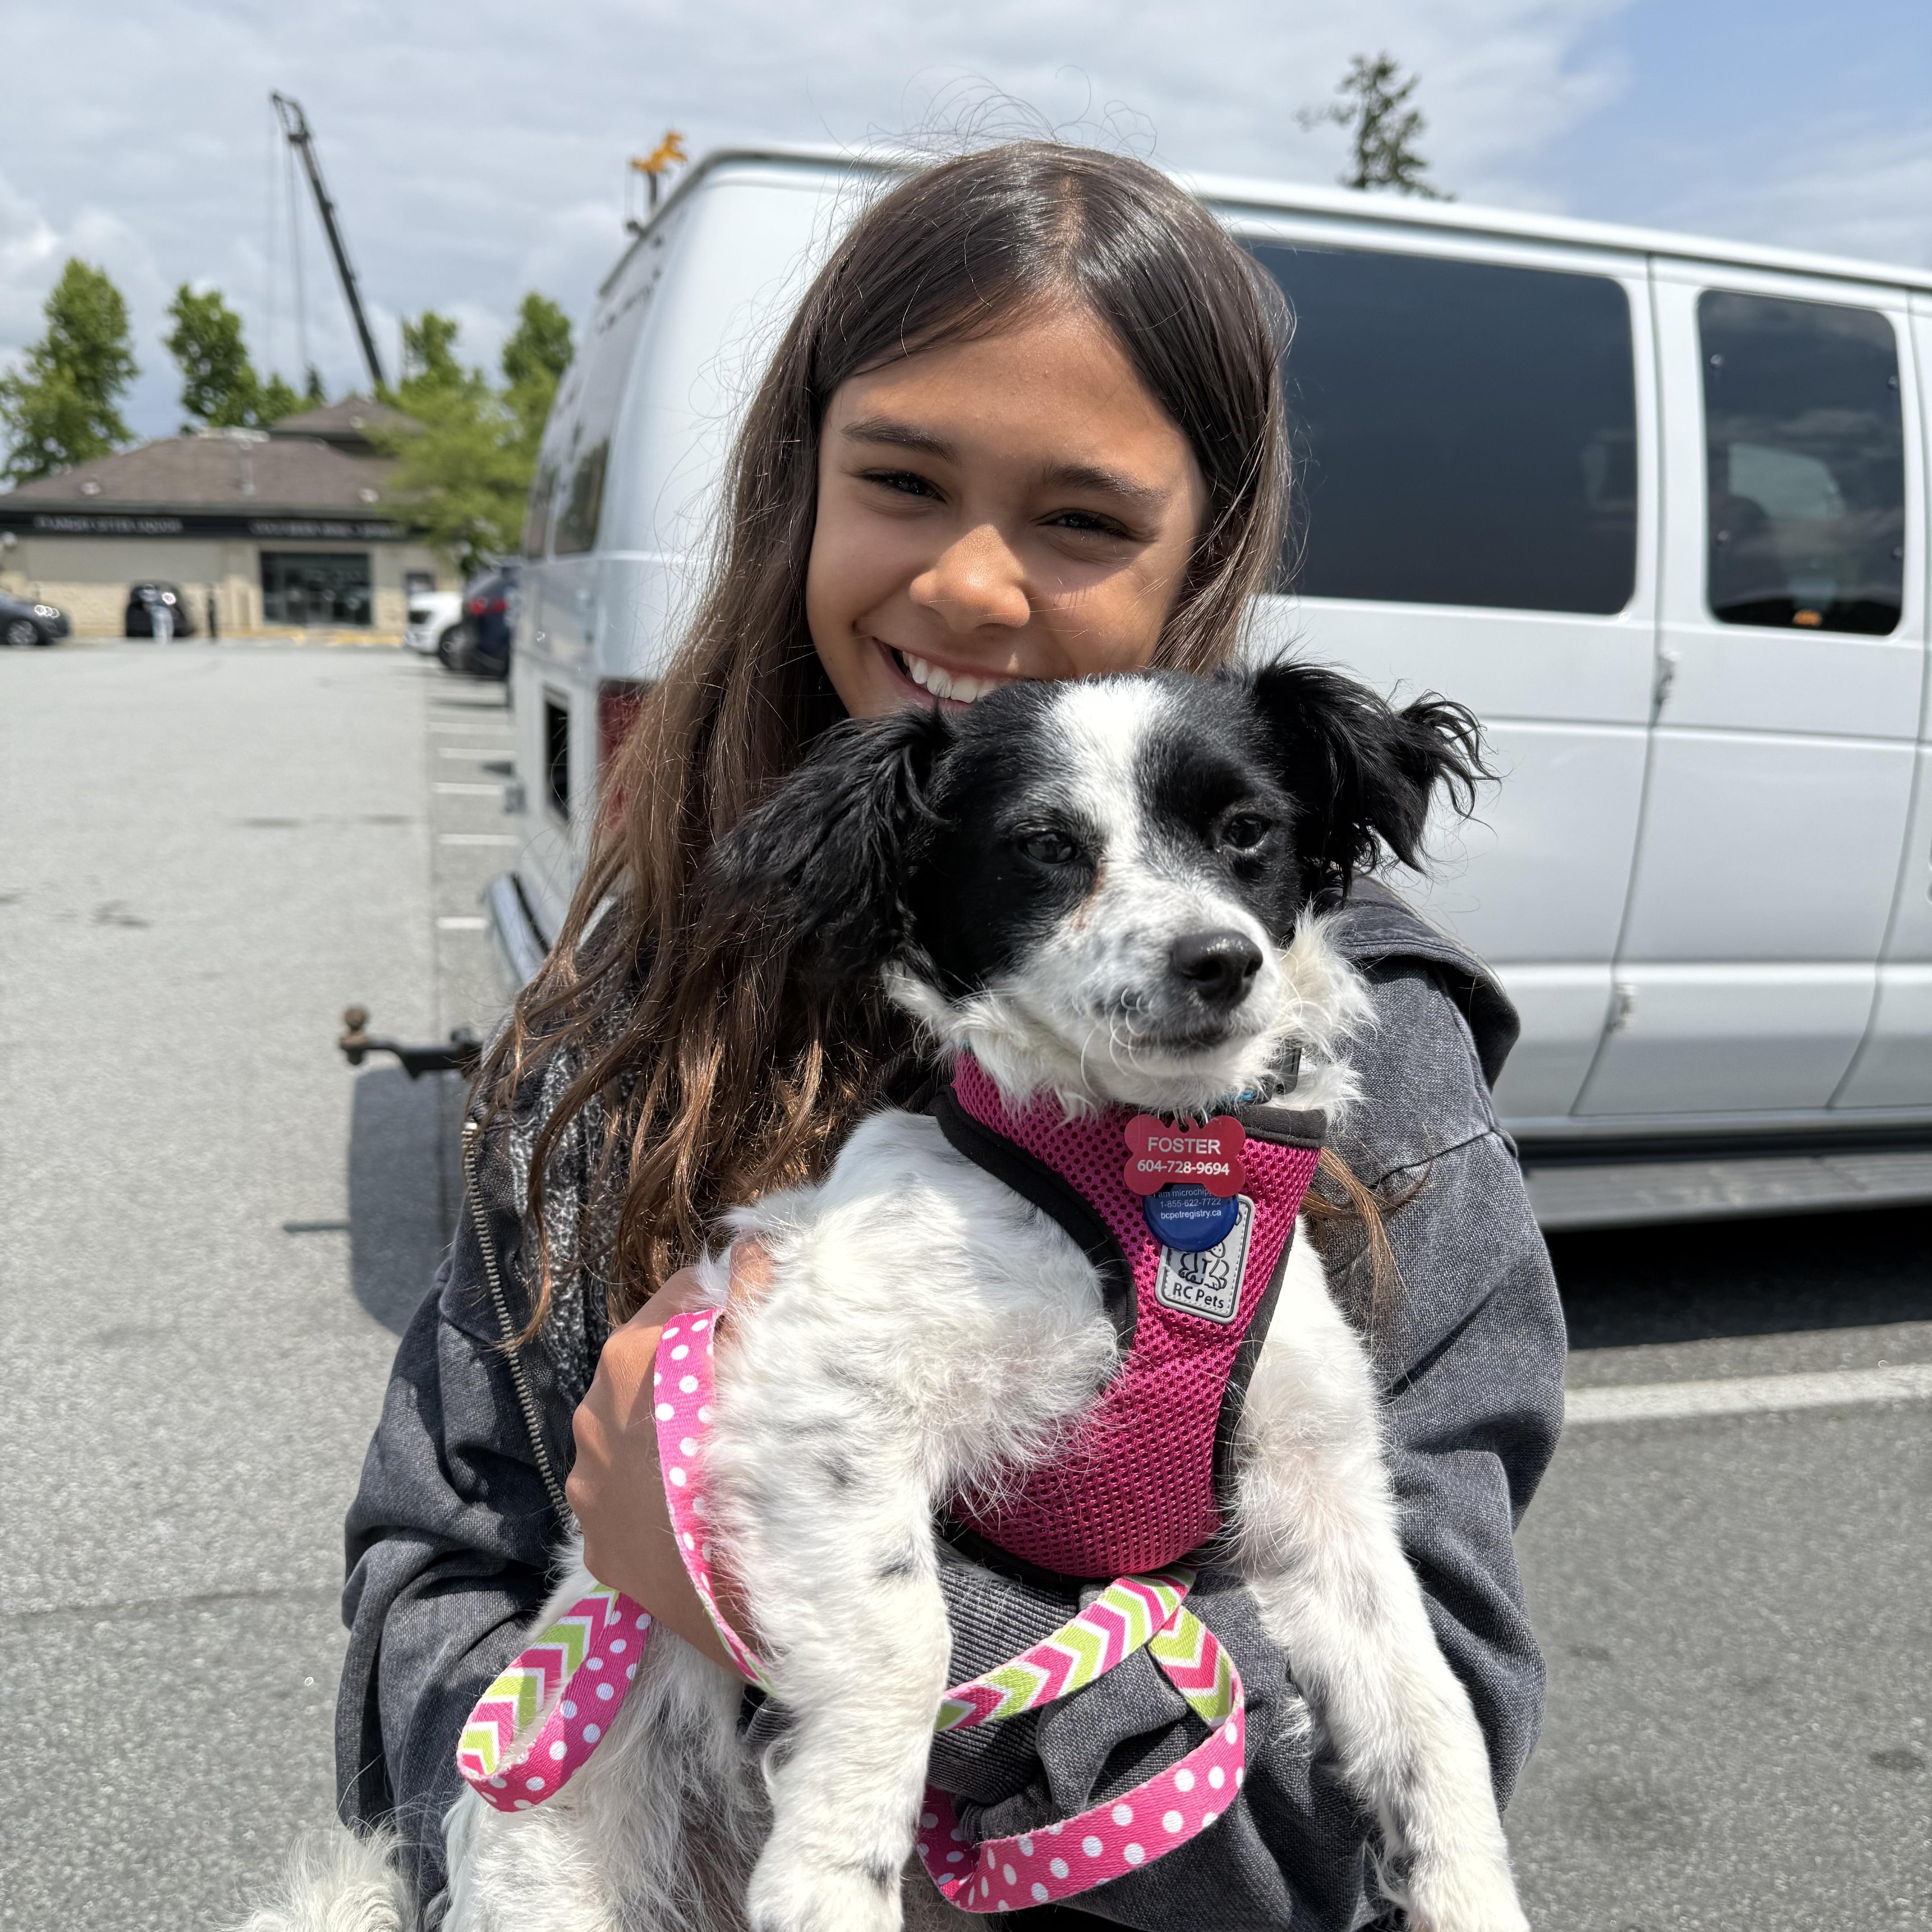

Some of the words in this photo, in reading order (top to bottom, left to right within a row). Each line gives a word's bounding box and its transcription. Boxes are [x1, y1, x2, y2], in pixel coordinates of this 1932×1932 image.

[1148, 1137, 1221, 1155] FOSTER
[1137, 1159, 1230, 1175] 604-728-9694
[1160, 1198, 1221, 1208] 1-855-622-7722
[1160, 1209, 1221, 1220] bcpetregistry.ca
[1173, 1282, 1193, 1299] RC
[1196, 1289, 1224, 1308] Pets
